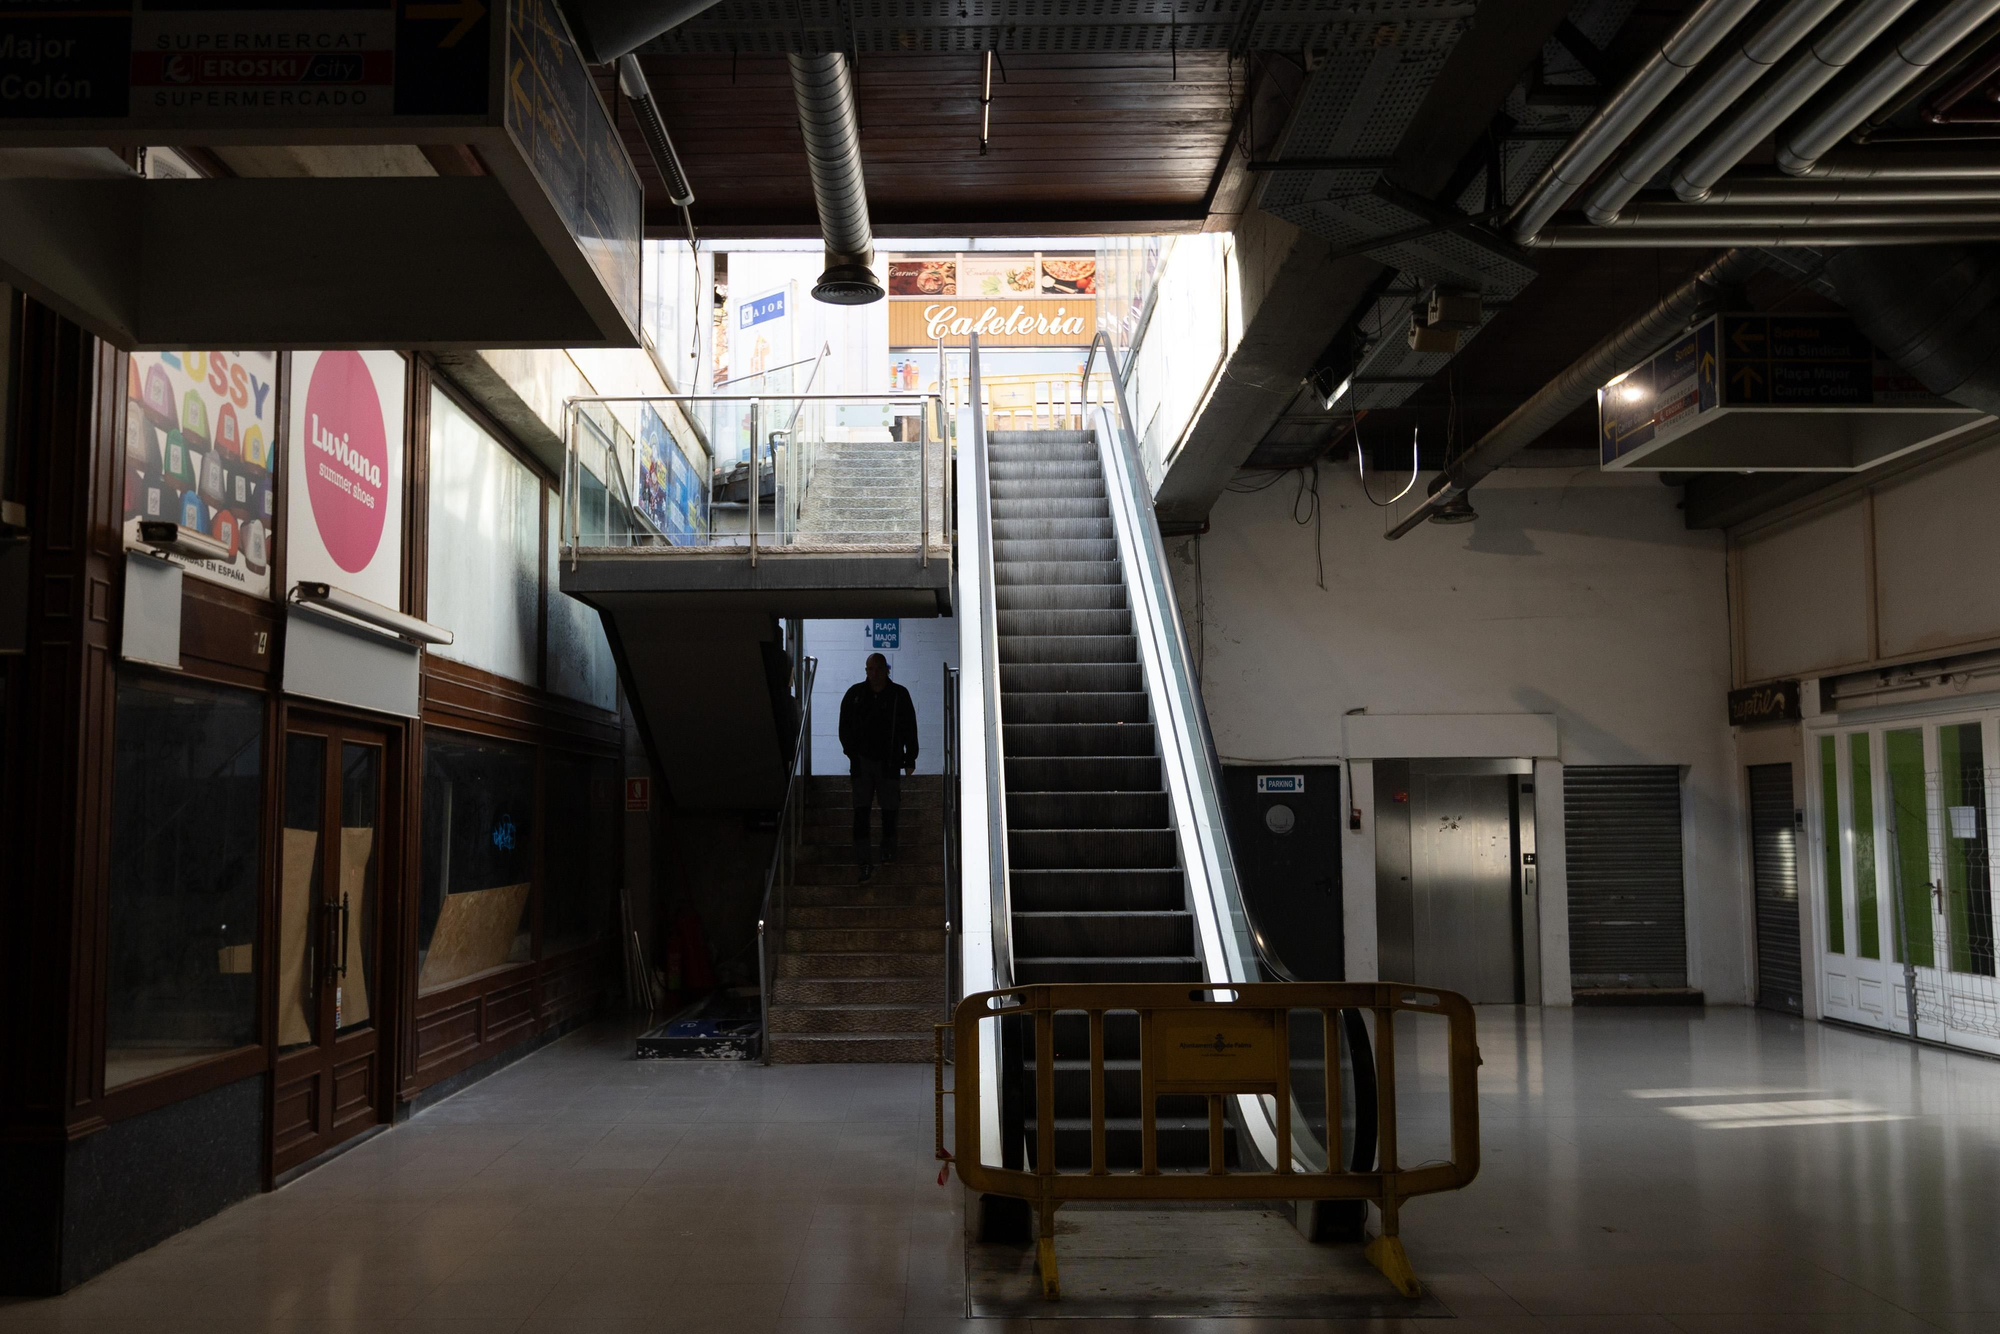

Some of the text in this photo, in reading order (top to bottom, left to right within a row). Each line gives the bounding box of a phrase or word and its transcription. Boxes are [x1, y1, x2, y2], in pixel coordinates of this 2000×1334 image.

[157, 33, 367, 50] SUPERMERCAT
[203, 59, 356, 79] EROSKI city
[1, 72, 93, 101] Colón
[155, 91, 367, 106] SUPERMERCADO
[889, 265, 919, 278] Carnes
[923, 304, 1085, 340] Cafeteria
[1774, 344, 1795, 356] Via
[1775, 367, 1850, 382] Plaça Major
[1775, 385, 1815, 396] Carrer
[312, 413, 382, 489] Luviana
[319, 462, 375, 509] summer shoes
[206, 560, 216, 572] EN
[217, 565, 245, 582] ESPAÑA
[875, 623, 896, 632] PLAÇA
[874, 633, 897, 642] MAJOR
[1268, 780, 1293, 788] PARKING
